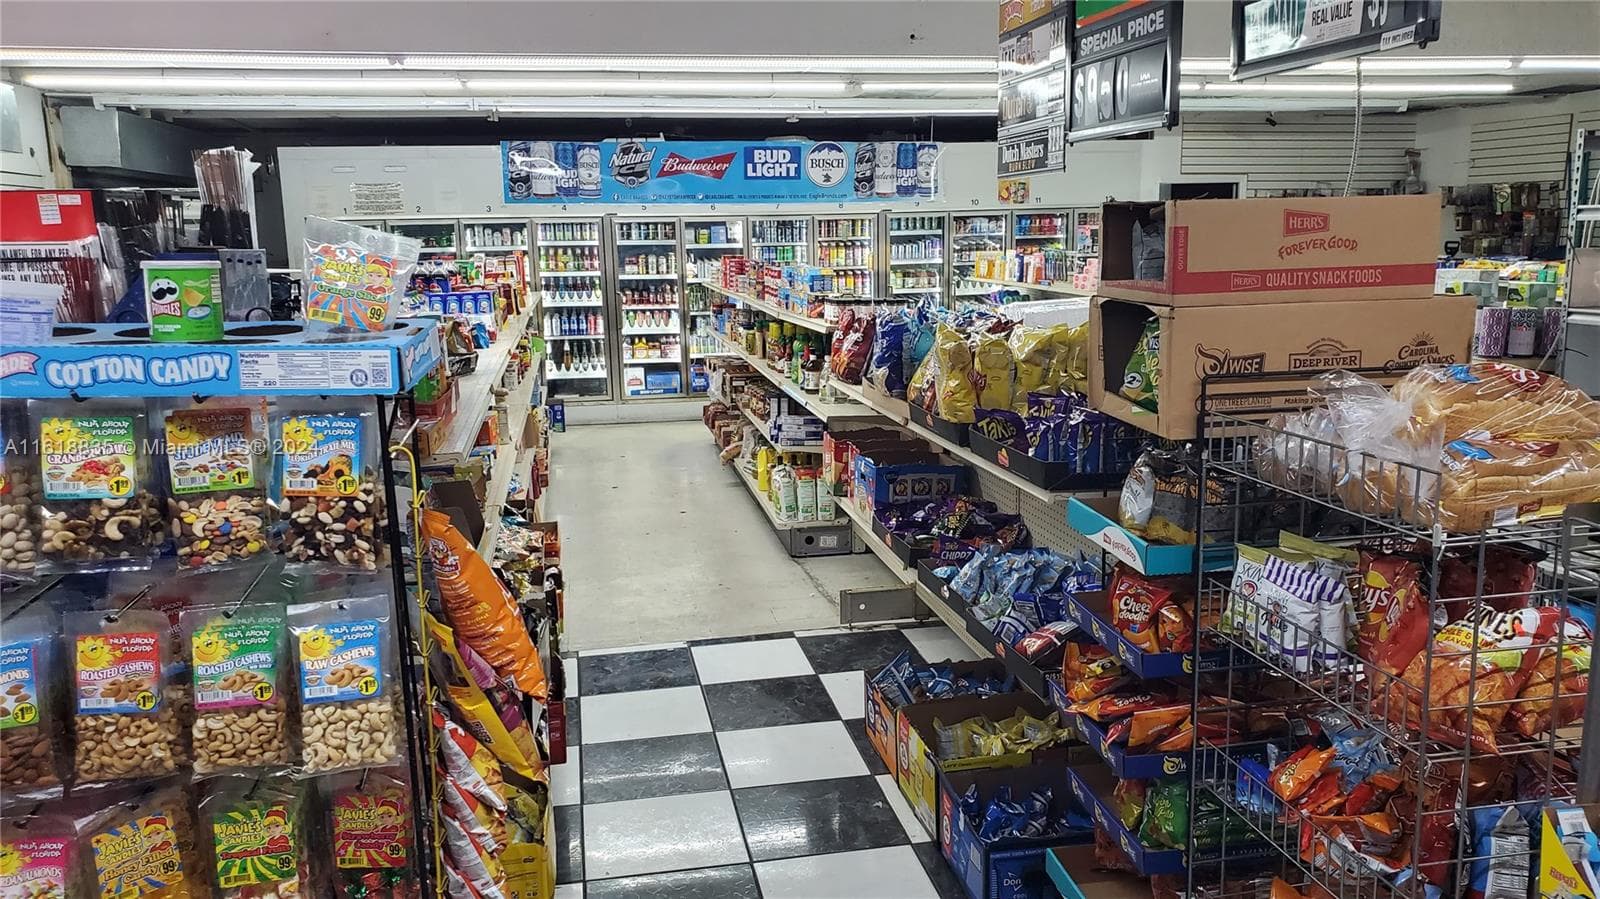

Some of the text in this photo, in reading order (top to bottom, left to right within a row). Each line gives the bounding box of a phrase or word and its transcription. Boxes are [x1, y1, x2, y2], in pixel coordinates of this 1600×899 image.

[1311, 10, 1329, 27] REAL
[1330, 5, 1353, 22] VALUE
[1080, 27, 1125, 57] SPECIAL
[1128, 9, 1165, 41] PRICE
[609, 147, 656, 168] Natural
[660, 156, 730, 173] Budweiser
[754, 149, 791, 164] BUD
[810, 158, 845, 169] BUSCH
[746, 163, 798, 177] LIGHT
[897, 168, 917, 177] BUD
[343, 207, 348, 215] 1
[1288, 215, 1325, 230] HERR'S
[0, 249, 28, 257] NLAWFUL
[1278, 234, 1358, 259] FOREVER GOOD
[1234, 268, 1382, 287] HERR'S QUALITY SNACK FOODS
[152, 301, 181, 317] PRINGLES
[1398, 345, 1440, 360] CAROLINA
[1228, 358, 1261, 374] WISE
[1293, 355, 1358, 369] DEEP RIVER
[47, 353, 231, 388] COTTON CANDY
[977, 416, 1017, 440] Takis
[1120, 595, 1152, 614] Cheez
[197, 652, 272, 676] ROASTED CASHEWS
[305, 646, 376, 670] RAW CASHEWS
[0, 670, 30, 684] MONDS
[81, 661, 154, 681] ROASTED CASHEWS
[223, 834, 260, 845] CANDIES
[104, 848, 175, 881] Honey Filled
[22, 867, 62, 883] ALMONDS
[124, 867, 159, 885] Candy
[1003, 878, 1022, 887] Don
